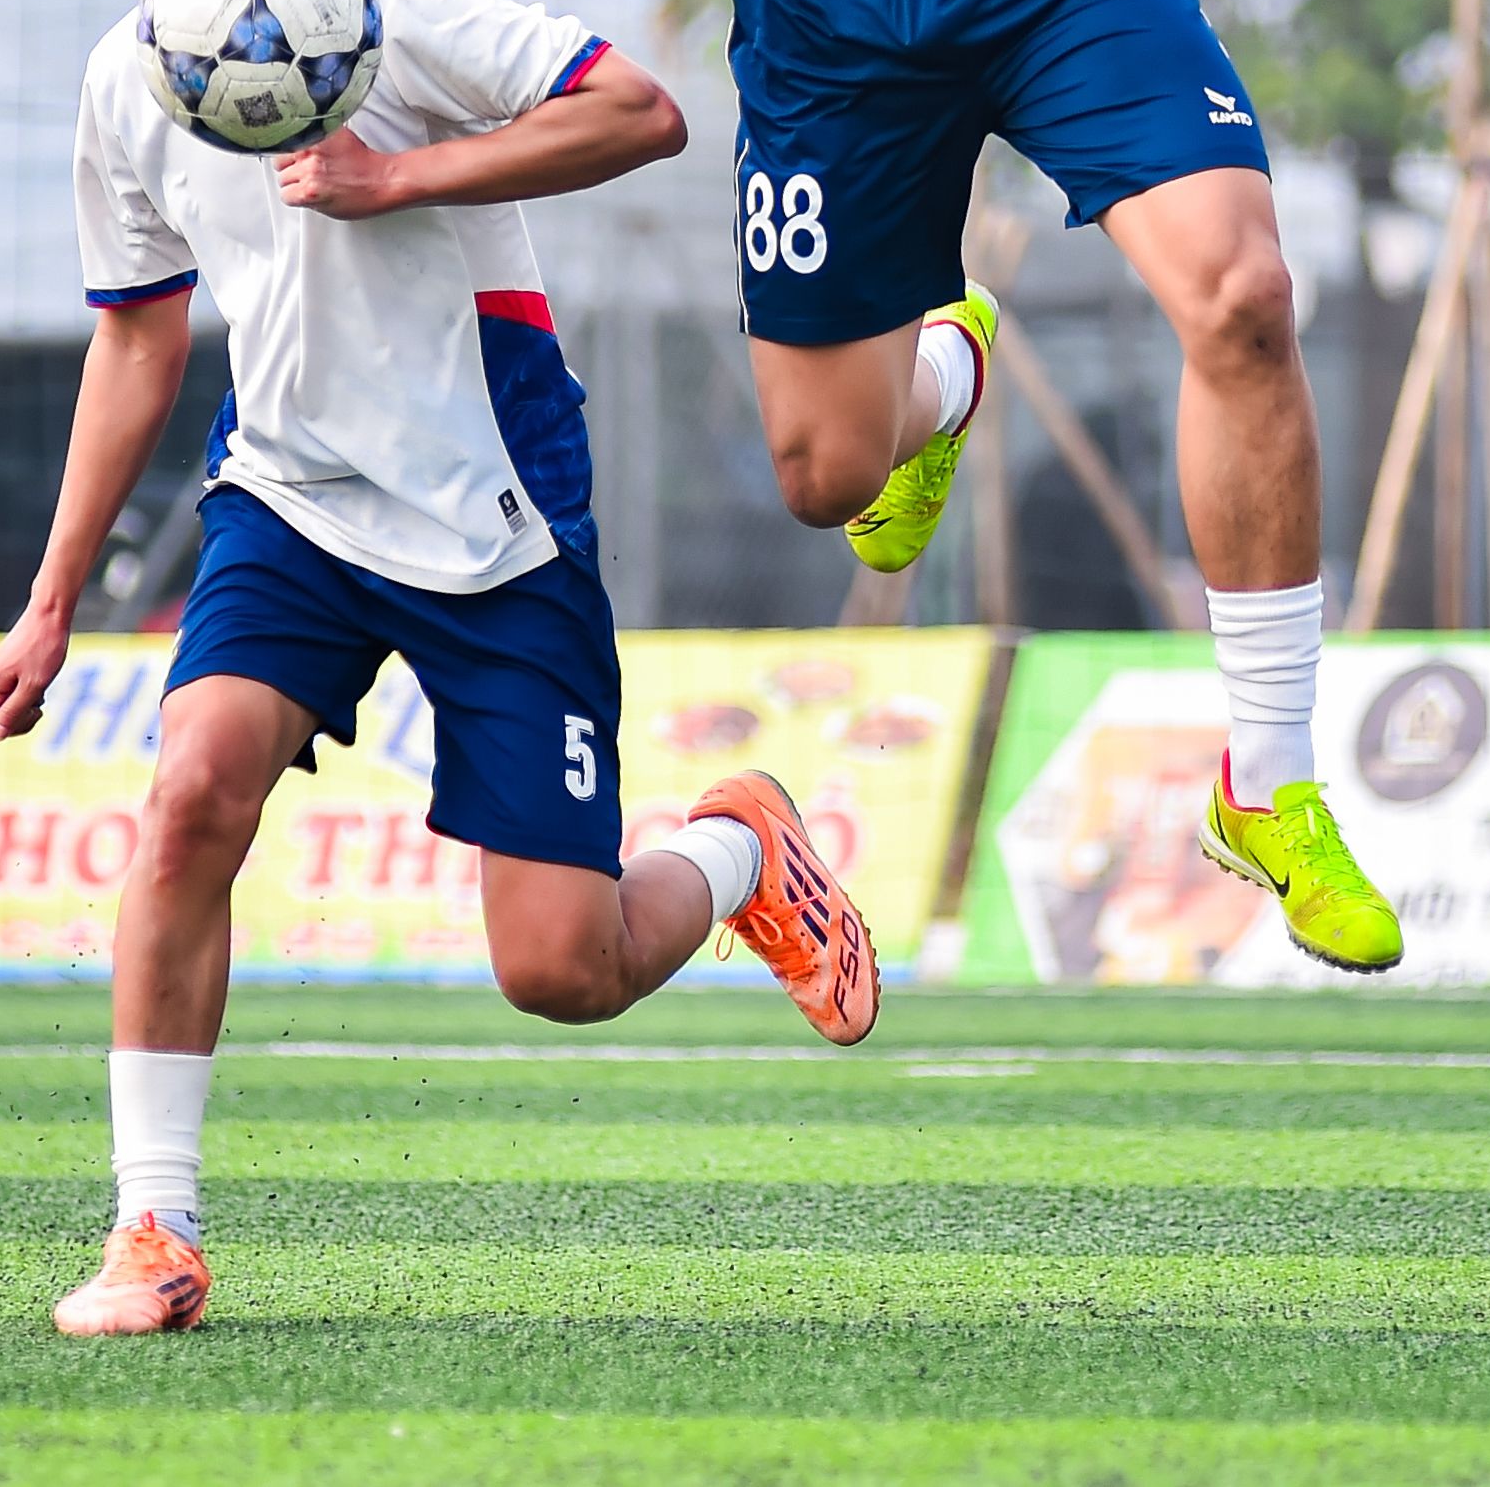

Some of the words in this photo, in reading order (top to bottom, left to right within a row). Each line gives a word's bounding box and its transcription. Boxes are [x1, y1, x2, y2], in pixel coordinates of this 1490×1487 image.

[744, 171, 828, 275] 88
[563, 712, 597, 802] 5
[833, 908, 861, 1024] F50
